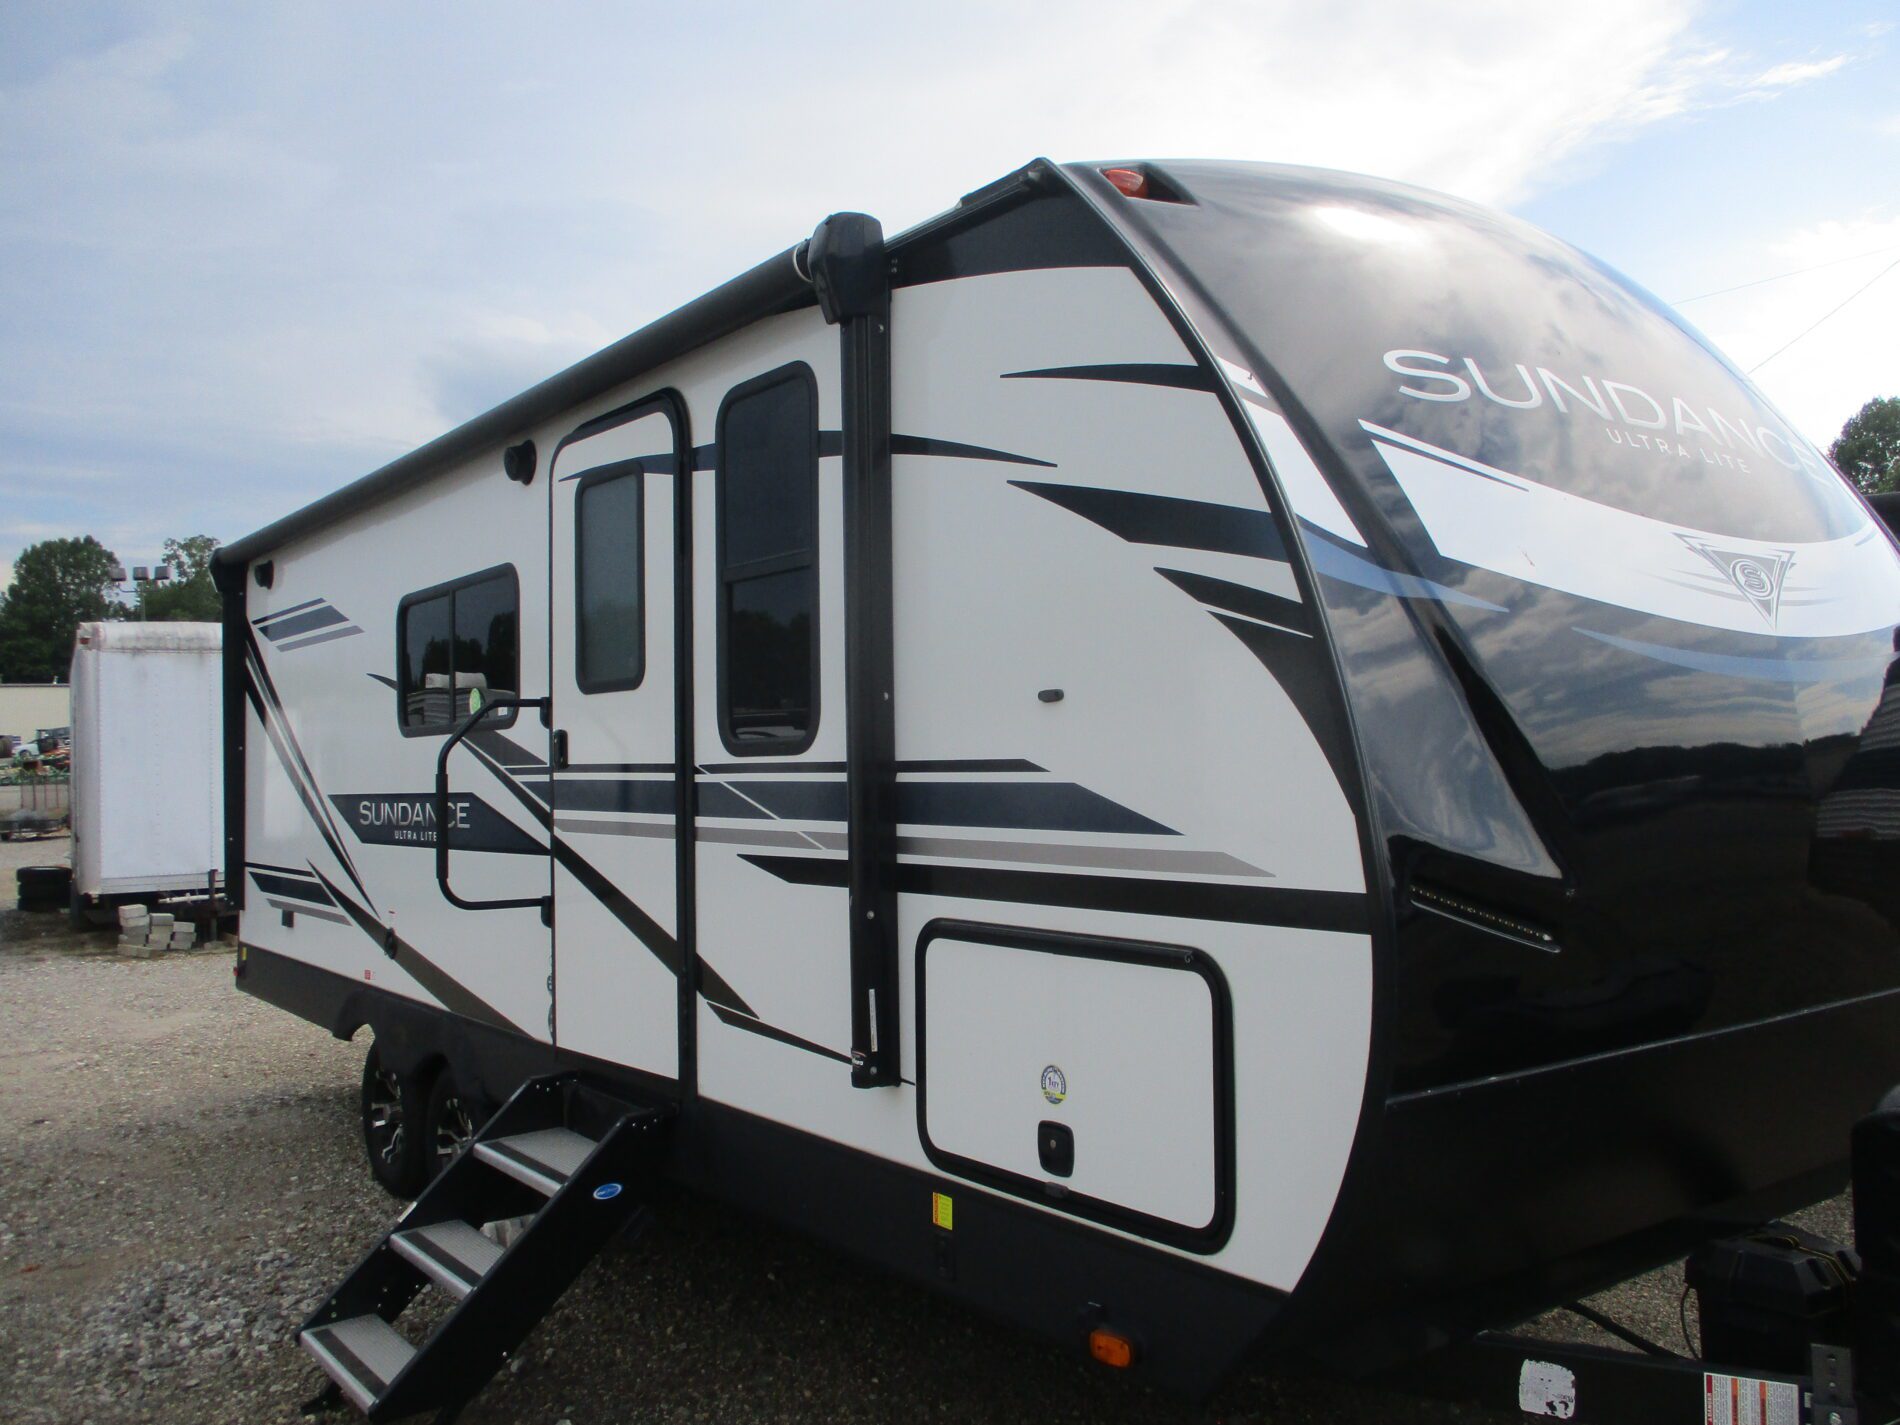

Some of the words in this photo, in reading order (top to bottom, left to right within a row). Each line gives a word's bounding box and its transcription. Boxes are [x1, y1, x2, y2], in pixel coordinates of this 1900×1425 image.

[1383, 349, 1833, 488] SUNDANCE
[1606, 427, 1691, 459] ULTRA
[1700, 448, 1751, 474] LITE
[394, 830, 417, 841] ULTRA
[420, 830, 438, 842] LITE
